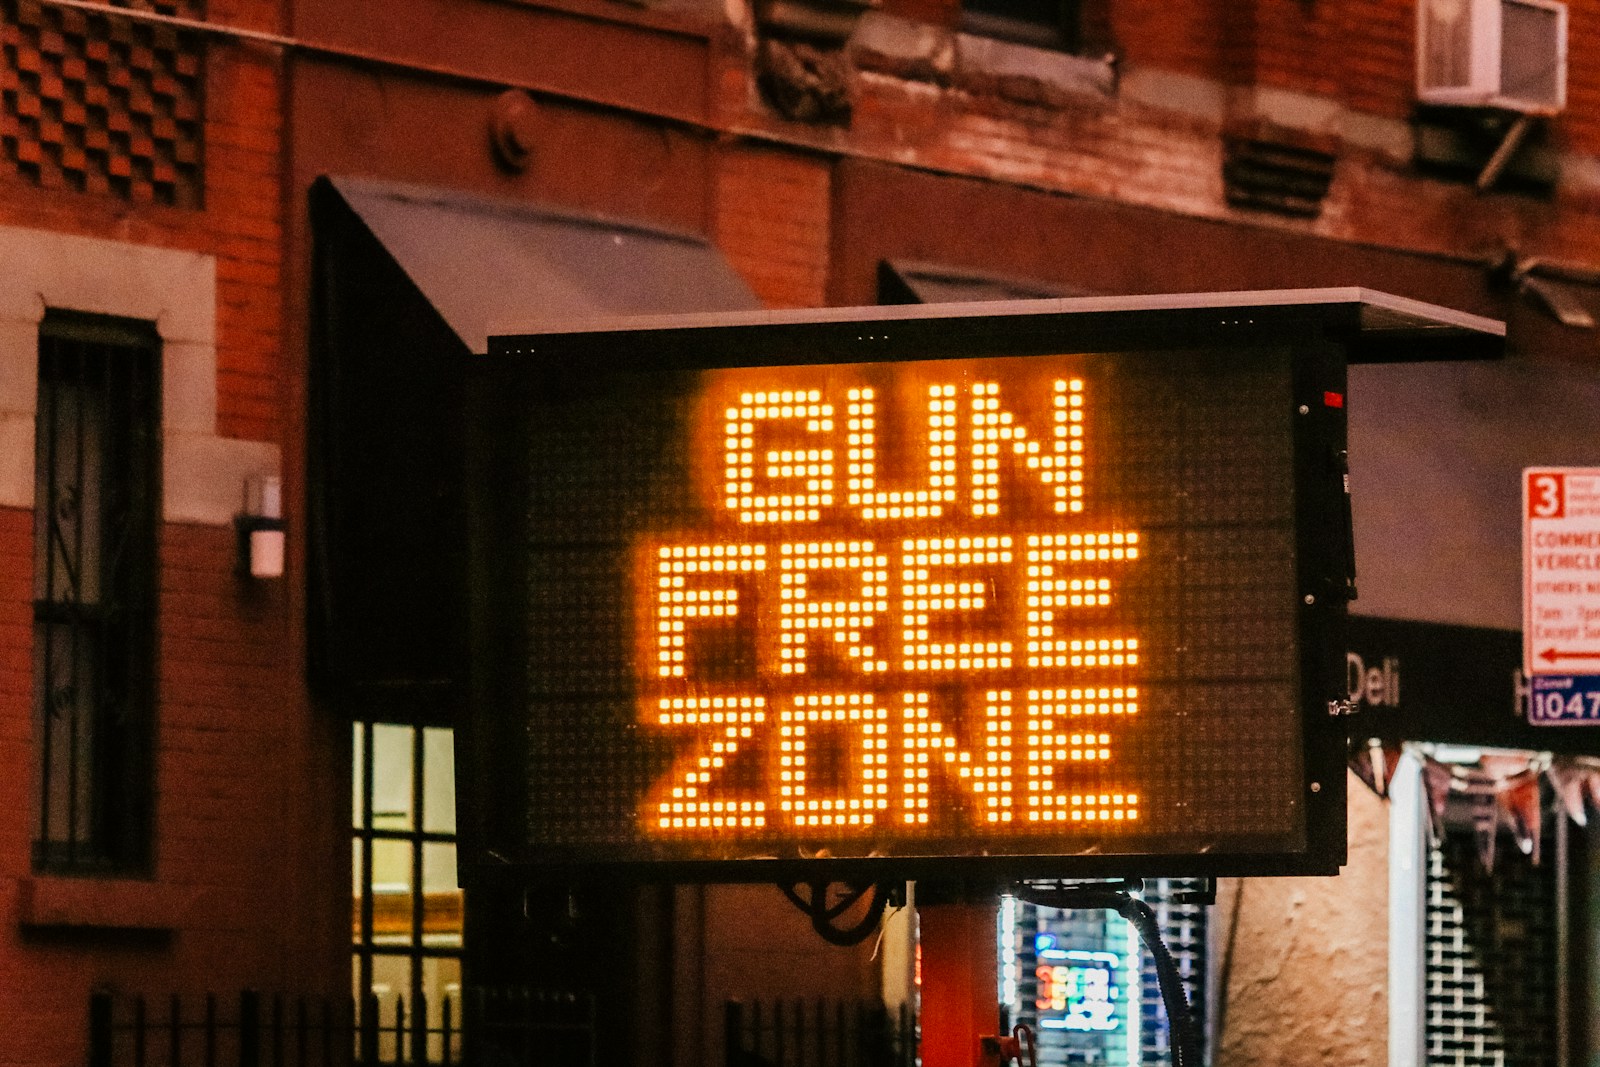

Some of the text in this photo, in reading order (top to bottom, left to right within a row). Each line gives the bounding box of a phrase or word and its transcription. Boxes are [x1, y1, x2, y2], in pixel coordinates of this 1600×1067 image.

[725, 378, 1083, 523] GUN
[1535, 477, 1558, 516] 3
[658, 532, 1140, 677] FREE
[1346, 652, 1400, 706] Deli
[658, 687, 1140, 829] ZONE
